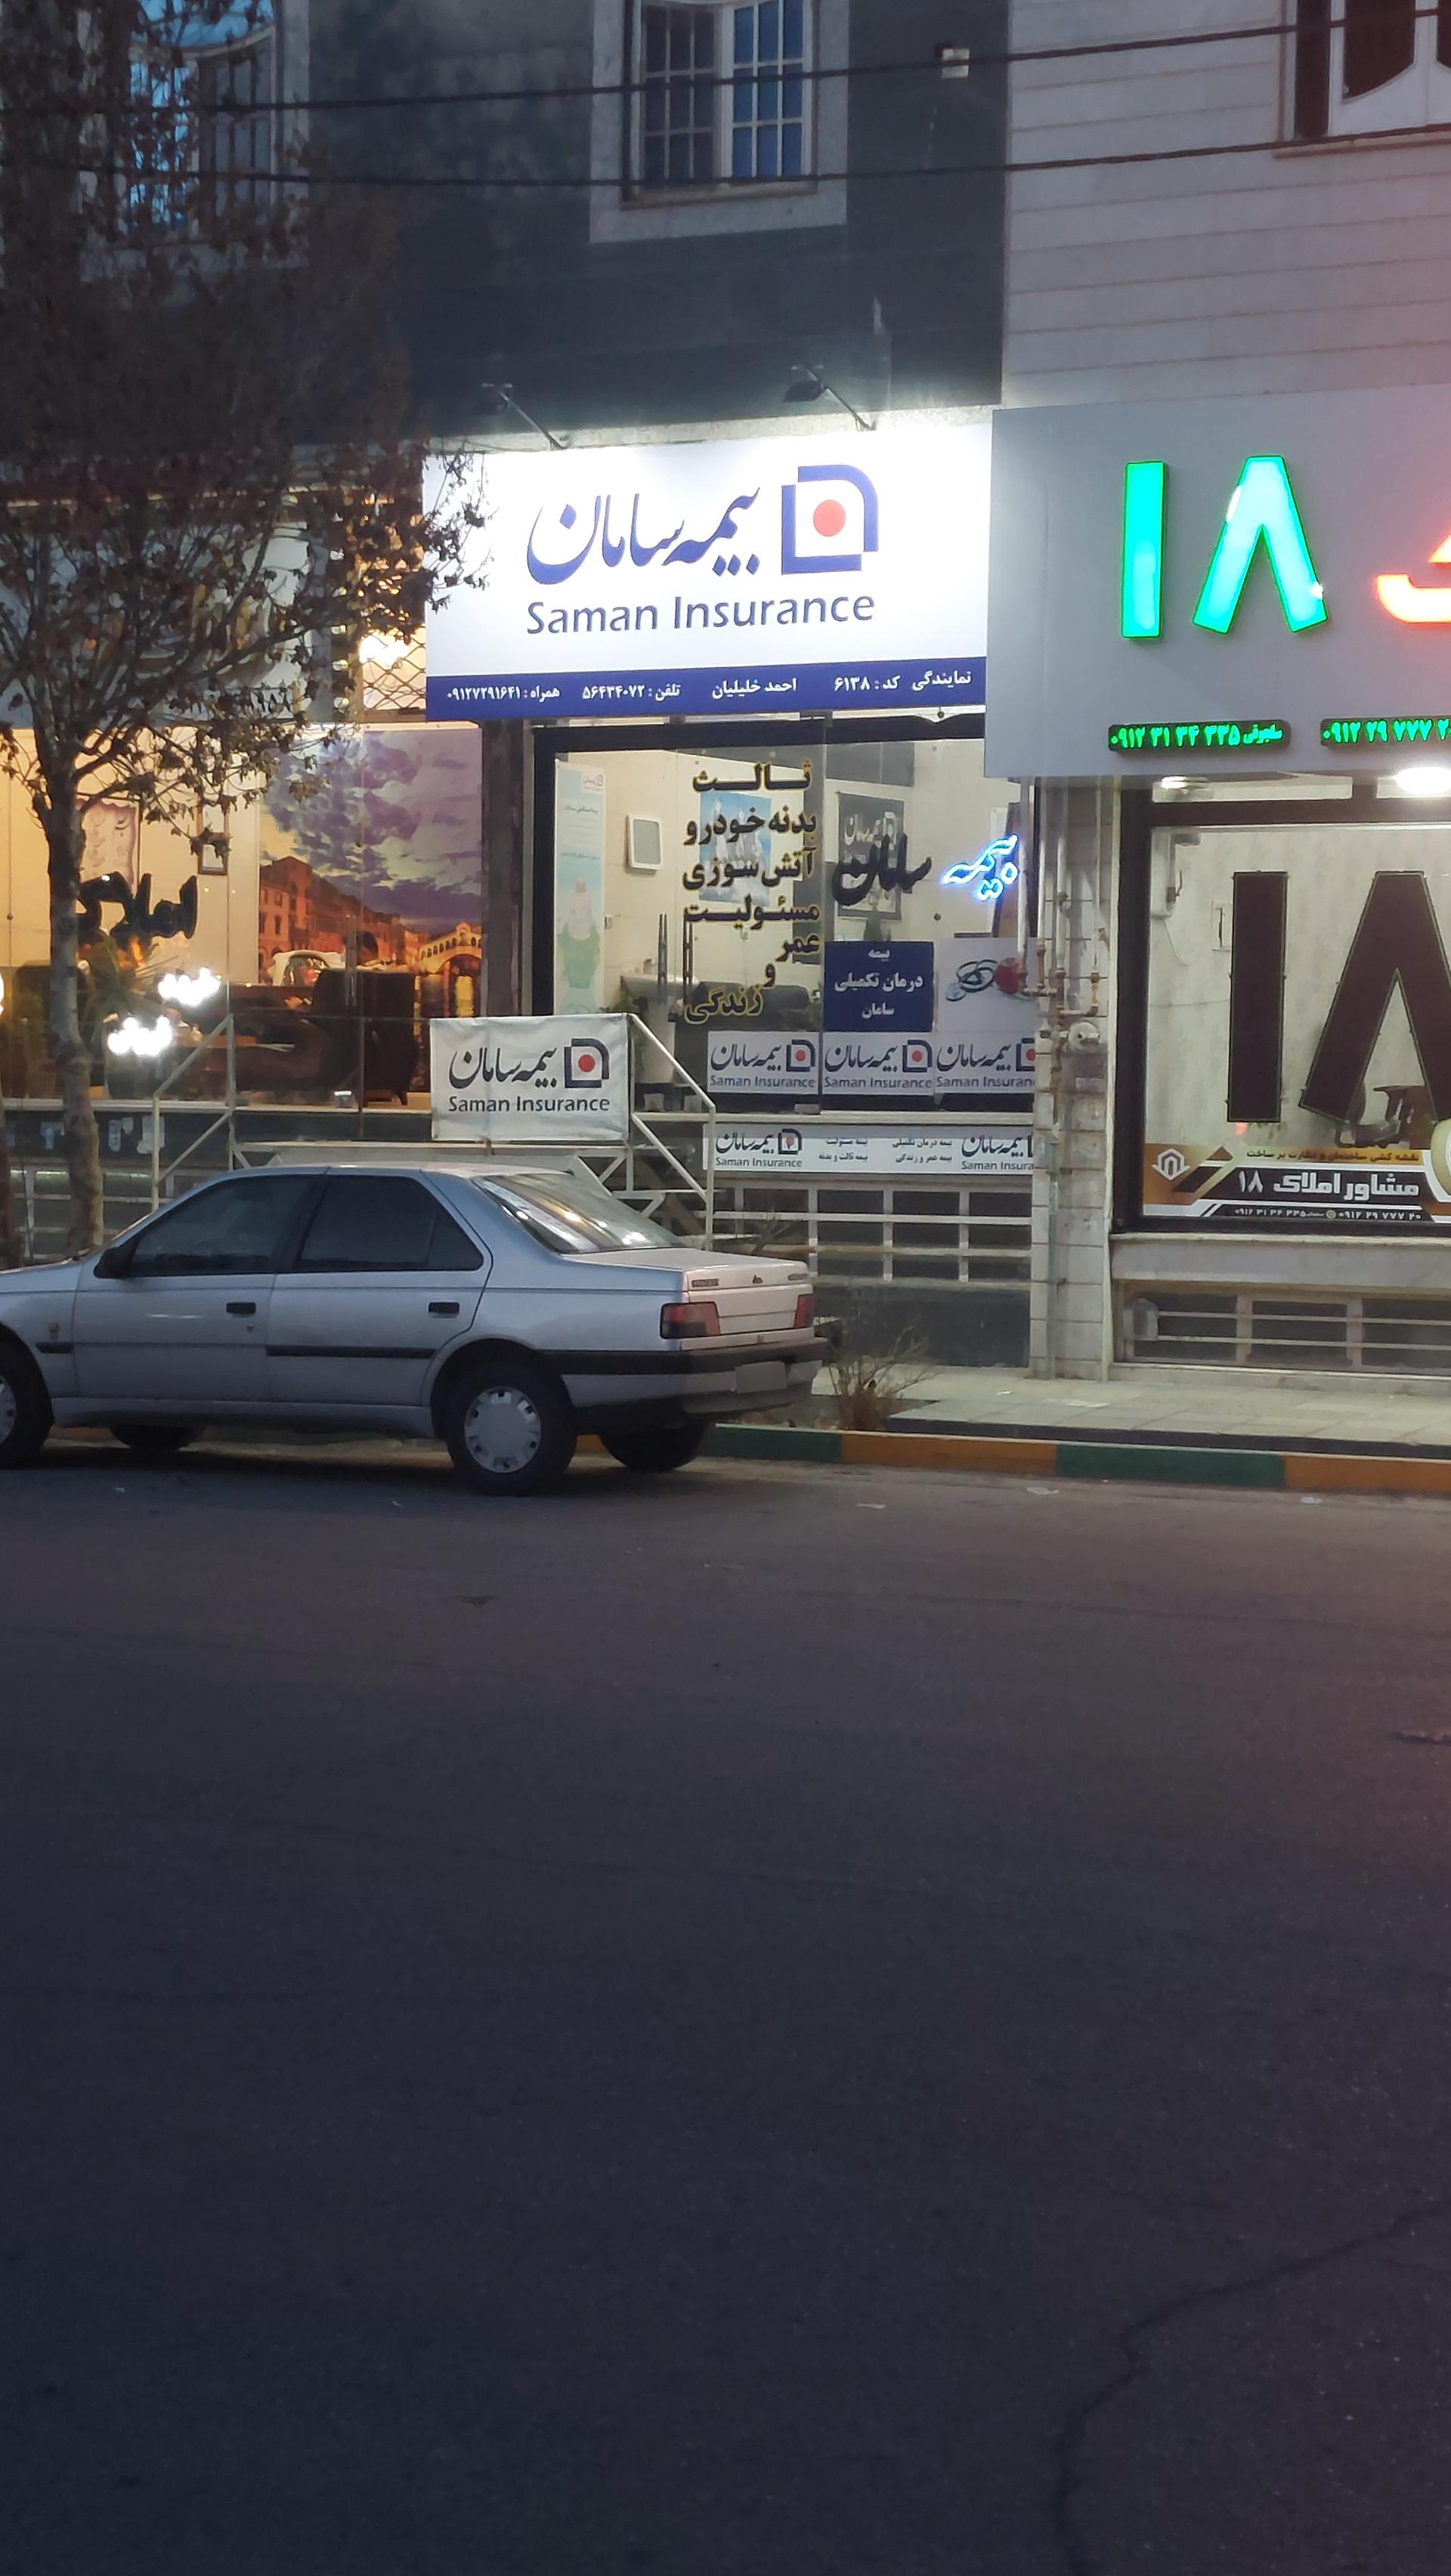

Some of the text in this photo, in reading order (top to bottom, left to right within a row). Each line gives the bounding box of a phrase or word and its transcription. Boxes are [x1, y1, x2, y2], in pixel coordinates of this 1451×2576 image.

[527, 486, 760, 585] بیمه سامان
[1122, 455, 1329, 638] ۱۸
[527, 594, 874, 635] Saman Insurance
[712, 679, 762, 699] خلیلیان
[764, 678, 797, 692] احمد
[834, 676, 871, 691] ۶۱۳۸
[912, 670, 972, 691] نمایندگی
[1110, 726, 1146, 748] ۰۹۱۲
[1323, 721, 1361, 743] ۰۹۱۲
[1393, 719, 1433, 742] ۷۷۷
[1437, 718, 1451, 741] ۲
[693, 759, 811, 792] ثالث
[683, 807, 766, 846] خودرو
[769, 805, 817, 840] بدنه
[682, 857, 759, 890] سوزی
[762, 846, 817, 887] آتش
[942, 833, 1019, 901] بیمه
[684, 894, 820, 930] مسئولیت
[775, 935, 820, 962] عمر
[868, 948, 890, 960] بیمه
[763, 963, 775, 988] و
[834, 971, 924, 992] درمان تکمیلی
[685, 985, 763, 1024] زندگی
[862, 1003, 895, 1019] سامان
[449, 1047, 558, 1090] بیمه سامان
[710, 1044, 781, 1072] بیمه سامان
[825, 1044, 897, 1072] بیمه سامان
[937, 1044, 1011, 1072] بیمه سامان
[710, 1075, 815, 1088] Saman Insurance
[825, 1078, 932, 1088] Saman Insurance
[937, 1077, 1035, 1088] Saman Insuran
[449, 1096, 610, 1112] Saman Insurance
[716, 1132, 775, 1155] بیمه سامان
[961, 1133, 1024, 1157] بیمه سامان
[716, 1157, 802, 1167] Saman Insurance
[961, 1160, 1033, 1170] Saman Insura
[1239, 1169, 1420, 1201] مشاور املاک ۱۸
